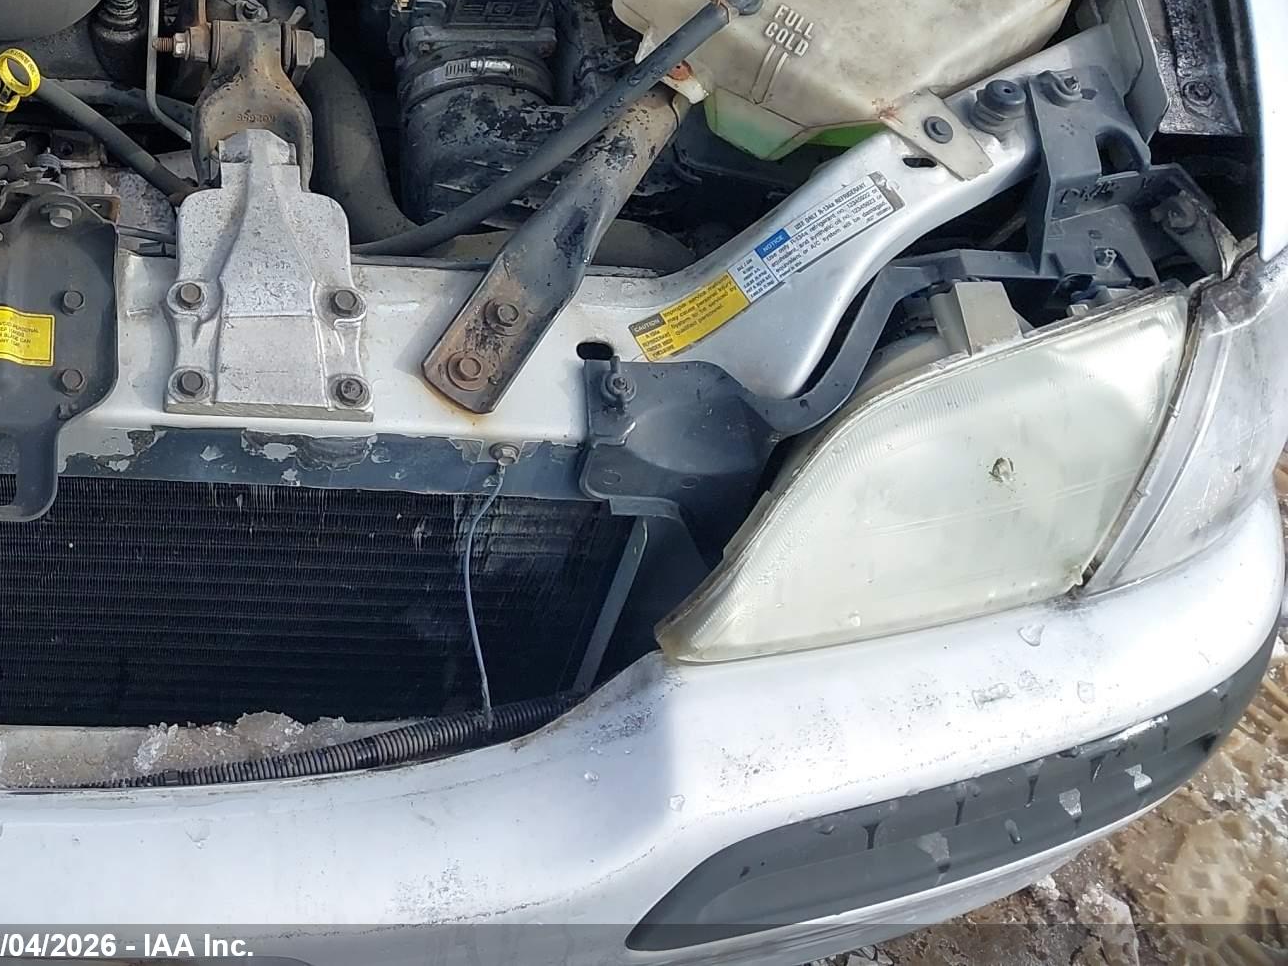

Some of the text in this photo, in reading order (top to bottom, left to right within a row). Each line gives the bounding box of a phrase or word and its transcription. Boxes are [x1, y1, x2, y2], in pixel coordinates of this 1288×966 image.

[775, 4, 814, 39] FULL
[765, 22, 809, 56] COLD
[803, 211, 818, 223] ONLY
[833, 181, 867, 205] REFRIGERANT
[761, 234, 786, 253] NOTICE
[765, 251, 778, 262] Use
[777, 243, 790, 254] only
[808, 213, 837, 233] refrigerant
[798, 238, 810, 248] and
[809, 240, 821, 250] A/C
[821, 227, 842, 243] system
[634, 318, 660, 332] CAUTION
